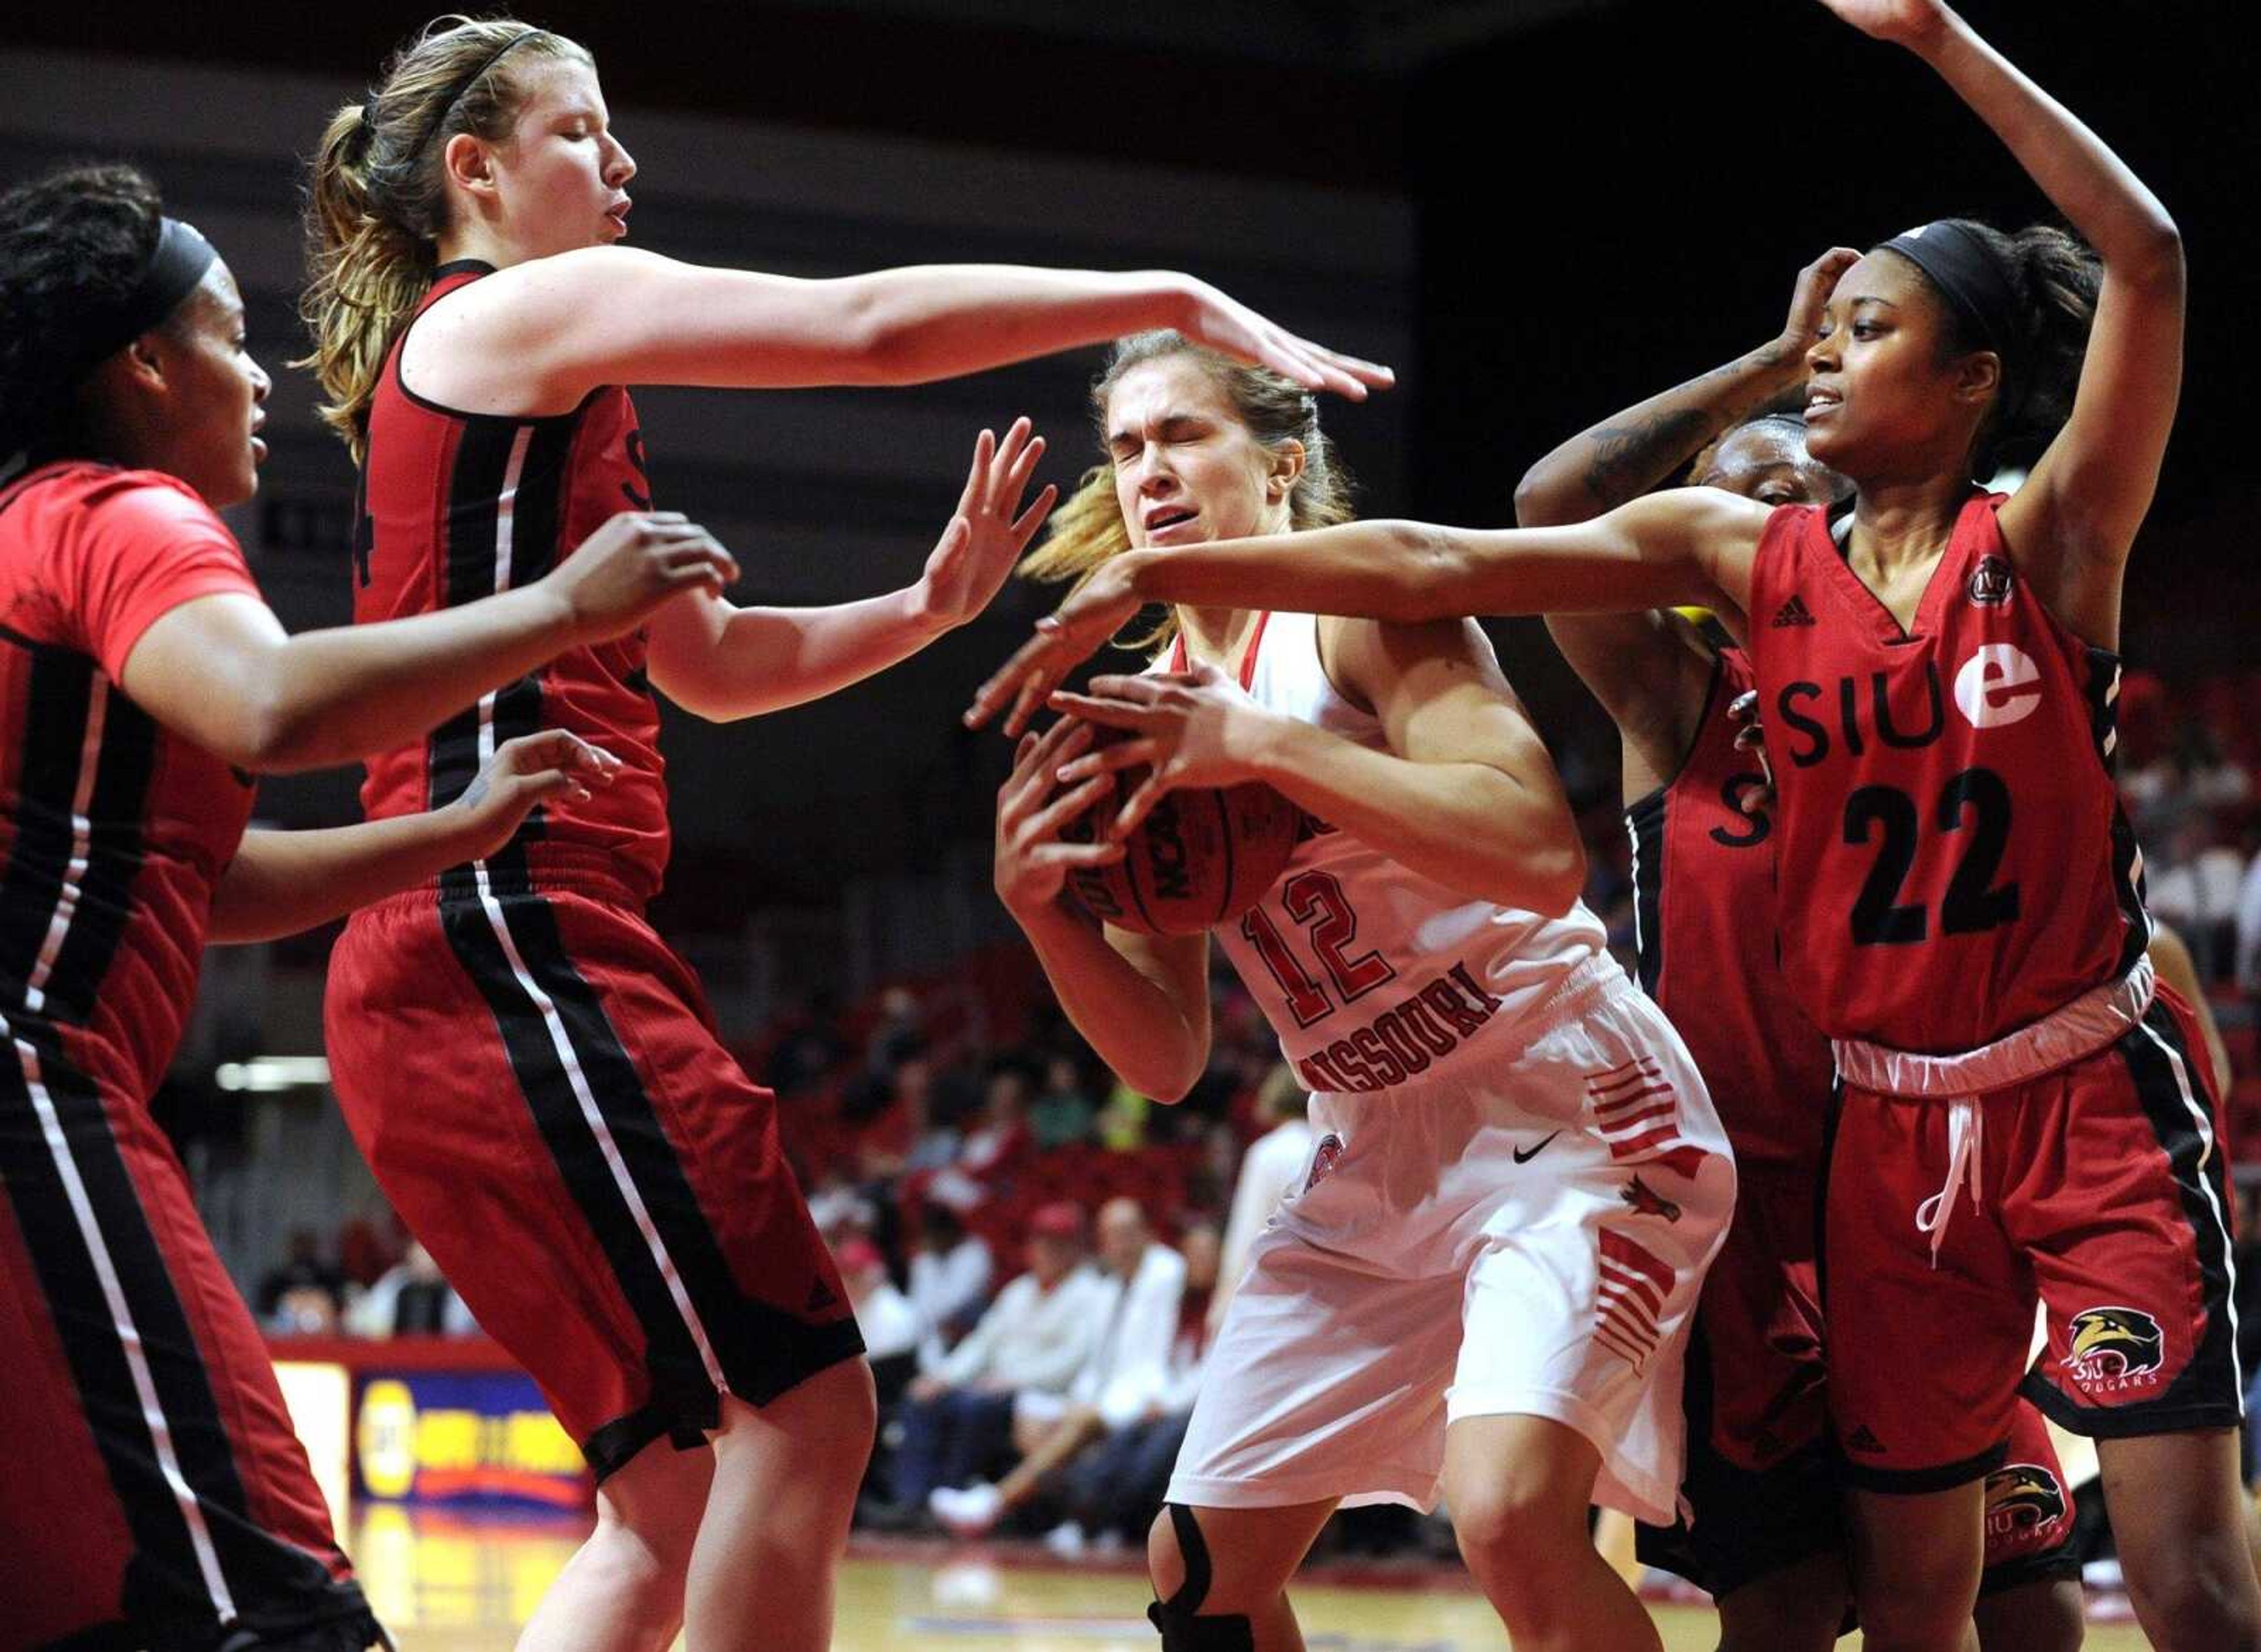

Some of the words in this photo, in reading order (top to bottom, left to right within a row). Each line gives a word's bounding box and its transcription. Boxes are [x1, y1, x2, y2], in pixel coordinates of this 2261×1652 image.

[1842, 768, 2021, 947] 22
[1241, 870, 1397, 1029] 12
[2081, 1373, 2157, 1393] OUGARS
